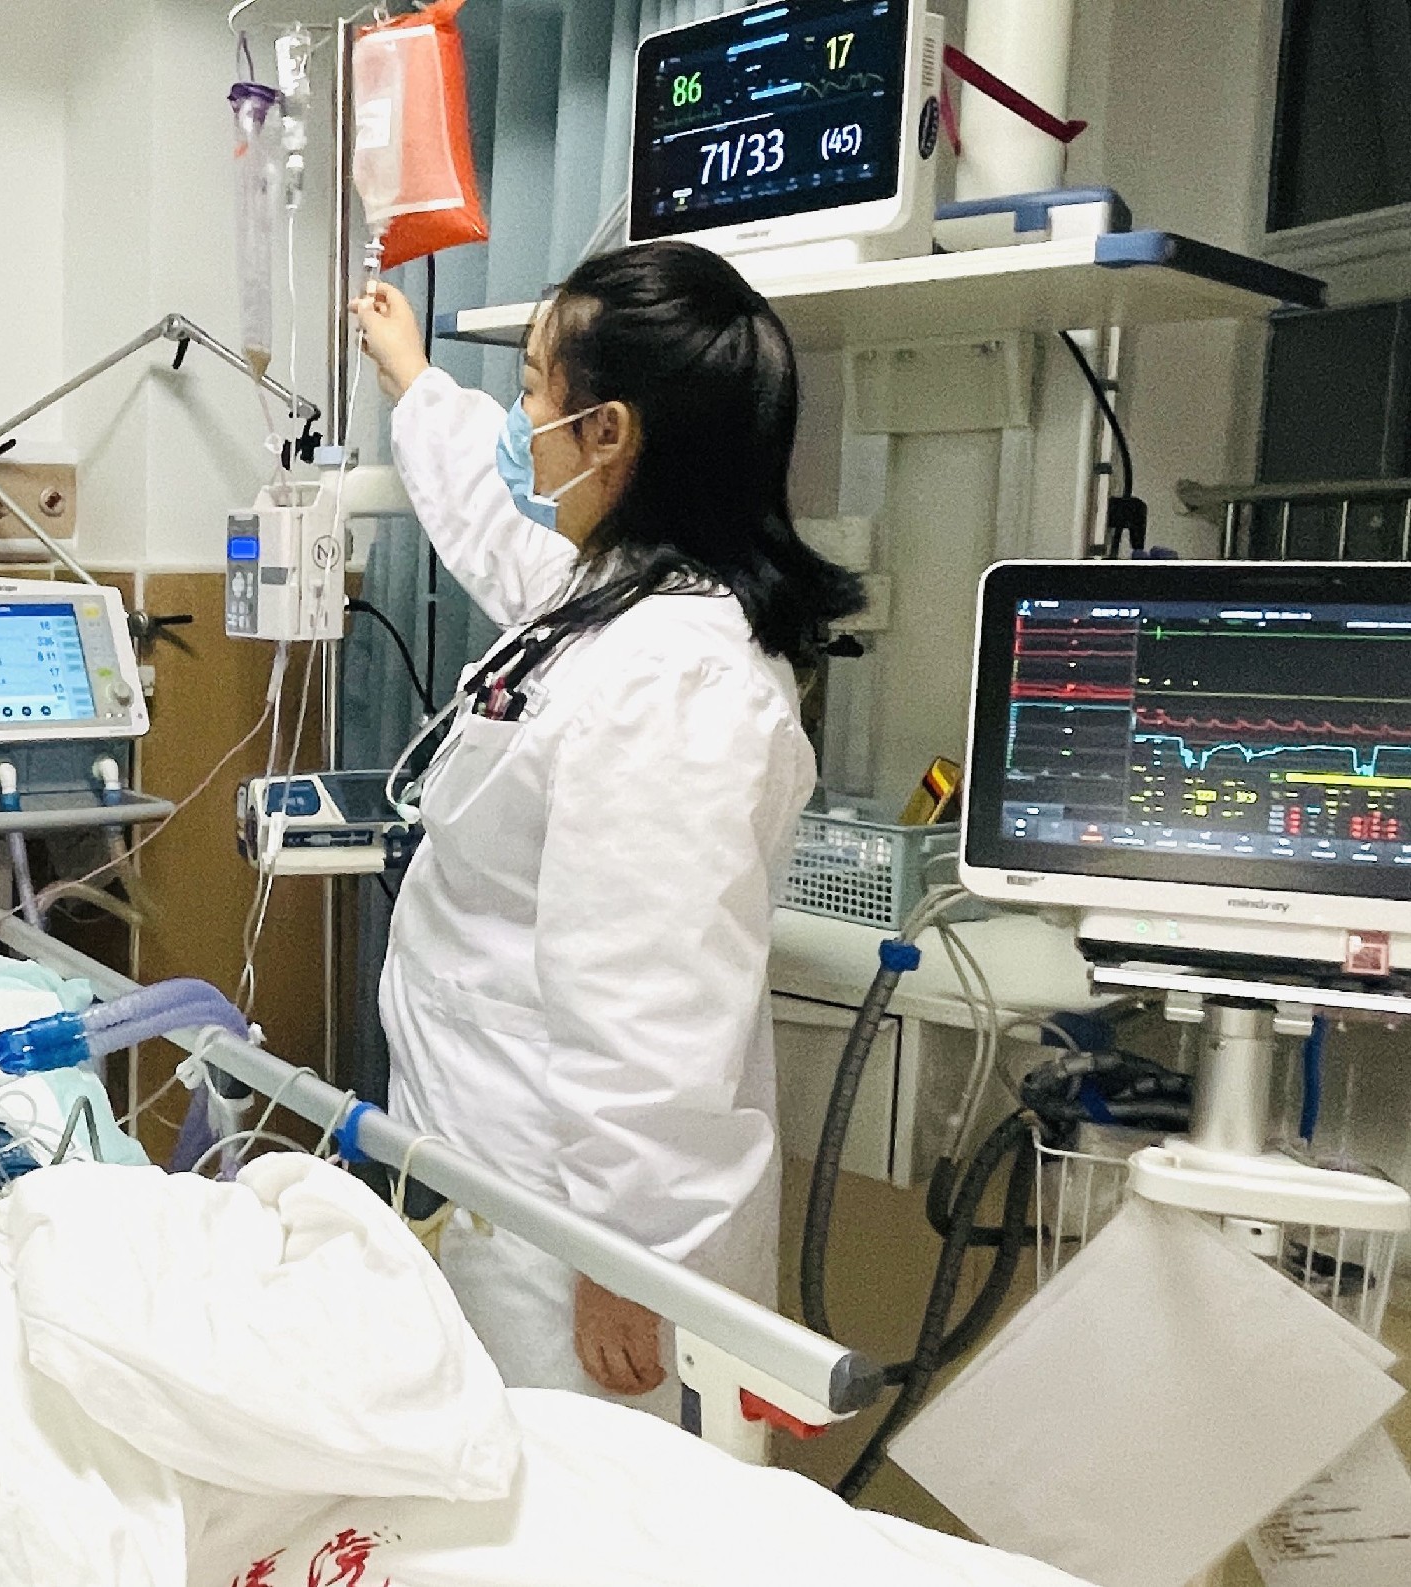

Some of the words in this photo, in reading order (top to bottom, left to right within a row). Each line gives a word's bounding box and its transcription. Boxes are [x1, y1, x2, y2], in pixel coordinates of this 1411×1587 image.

[826, 32, 855, 70] 17
[672, 71, 702, 107] 86
[700, 128, 785, 185] 71/33
[821, 123, 863, 160] (45)
